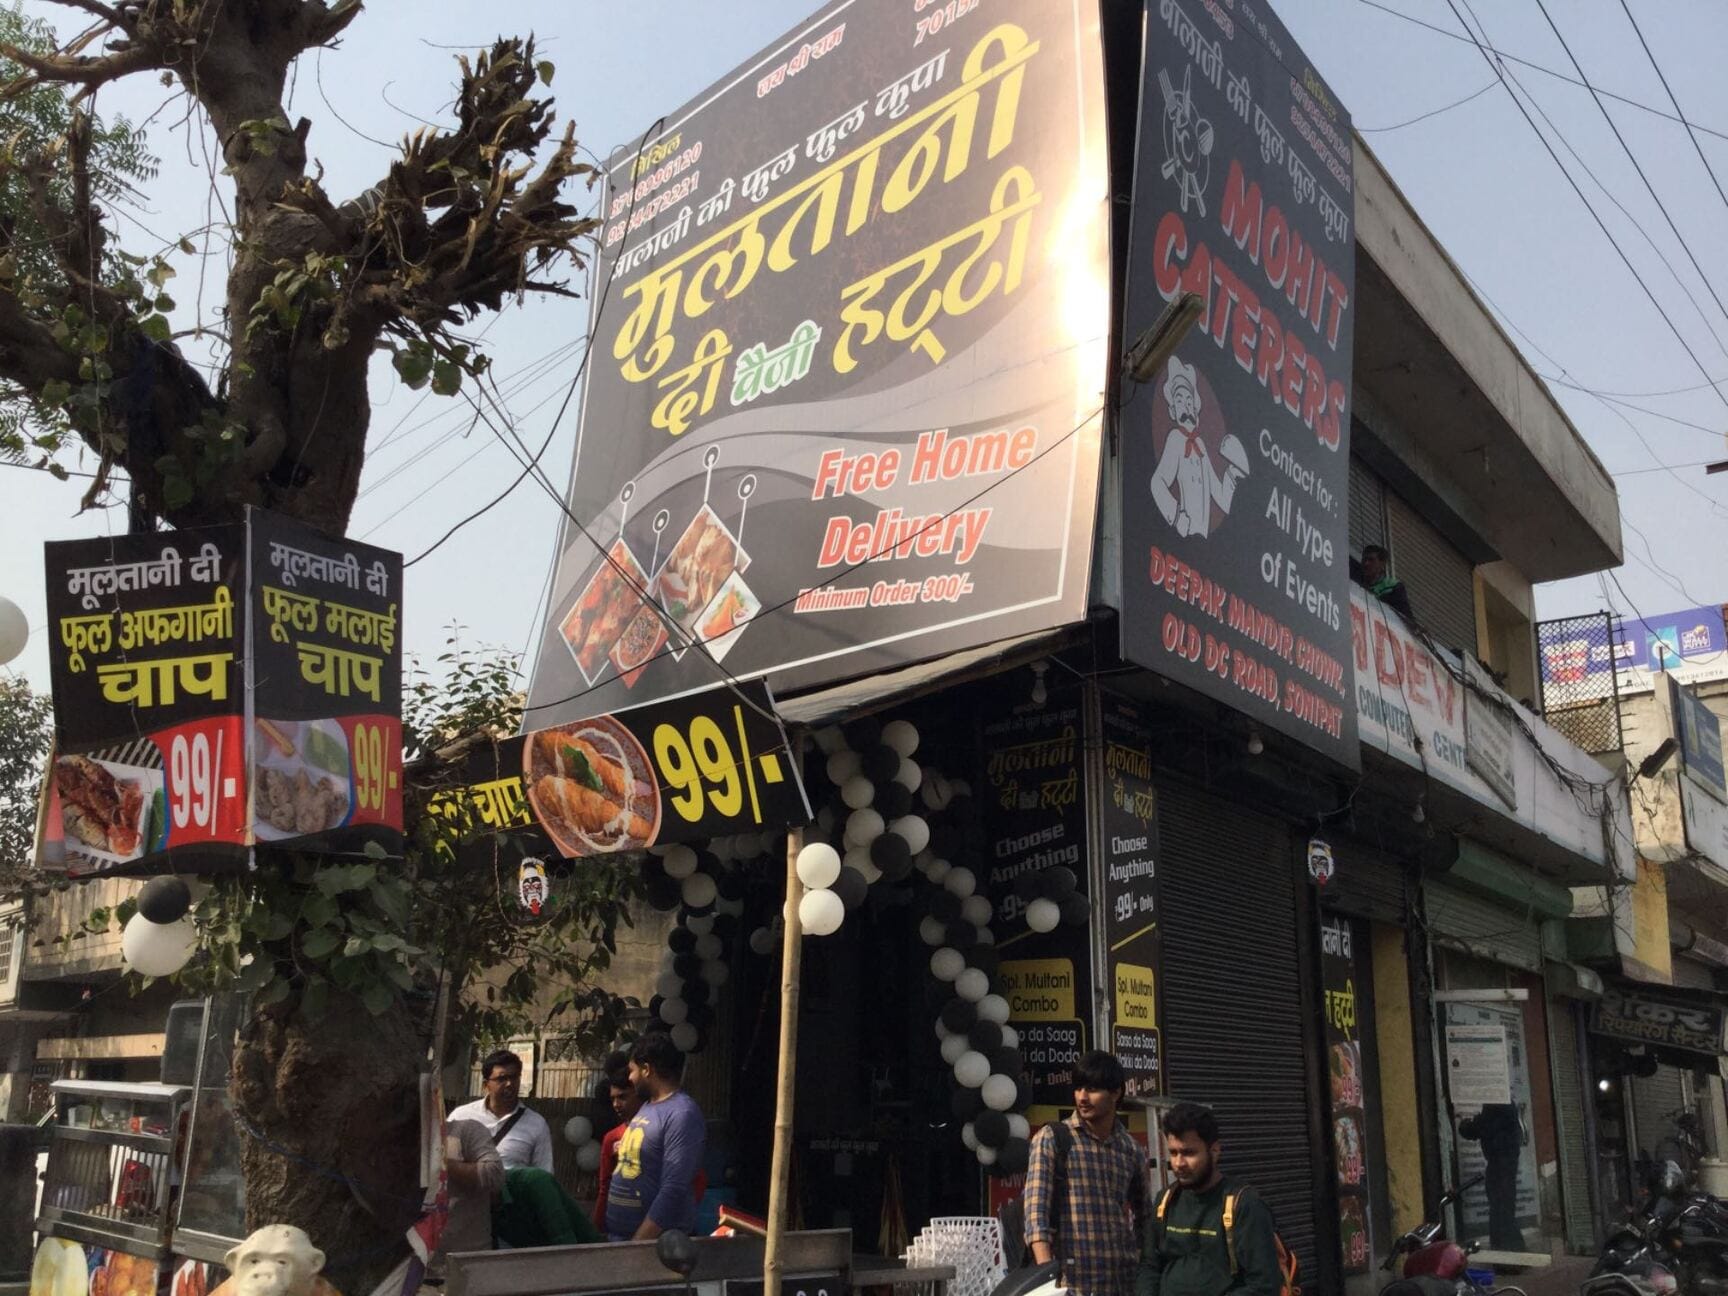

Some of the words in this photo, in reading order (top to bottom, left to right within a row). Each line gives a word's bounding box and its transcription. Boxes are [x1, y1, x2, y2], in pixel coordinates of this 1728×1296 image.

[1226, 70, 1251, 124] की
[697, 178, 736, 226] की
[875, 48, 950, 119] कृपा
[613, 23, 1041, 383] मुलतानी
[1220, 158, 1348, 351] MOHIT
[1153, 211, 1346, 452] CATERERS
[651, 328, 734, 435] दी
[811, 448, 902, 501] Free
[908, 424, 1039, 485] Home
[1259, 428, 1315, 497] Contact
[816, 506, 994, 568] Delivery
[1265, 486, 1292, 535] All
[1295, 507, 1334, 568] type
[67, 547, 182, 610] मूलतानी
[190, 543, 221, 582] दी
[270, 542, 360, 591] मूलतानी
[366, 561, 388, 598] दी
[793, 586, 870, 614] Minimum
[870, 579, 923, 608] Order
[922, 572, 975, 603] 300/-
[1149, 545, 1227, 624] DEEPAK
[1261, 550, 1282, 589] of
[1285, 559, 1341, 632] Events
[60, 612, 114, 673] फूल
[118, 585, 234, 650] अफगानी
[262, 585, 320, 644] फूल
[324, 600, 397, 655] मलाई
[97, 653, 233, 708] चाप
[297, 641, 383, 703] चाप
[1162, 612, 1202, 662] OLD
[1205, 633, 1230, 679] DC
[1232, 649, 1280, 711] ROAD,
[1284, 679, 1343, 740] SONIPAT
[171, 729, 236, 837] 99/-
[354, 723, 398, 820] 99/-
[652, 704, 785, 825] 99/-
[995, 823, 1065, 858] Choose
[1109, 858, 1154, 883] Anything
[1112, 836, 1147, 855] Choose
[1342, 919, 1352, 959] दी
[1012, 995, 1059, 1012] Combo
[1025, 972, 1071, 989] Multani
[1124, 1000, 1148, 1018] Combo
[1046, 1026, 1077, 1046] Saag
